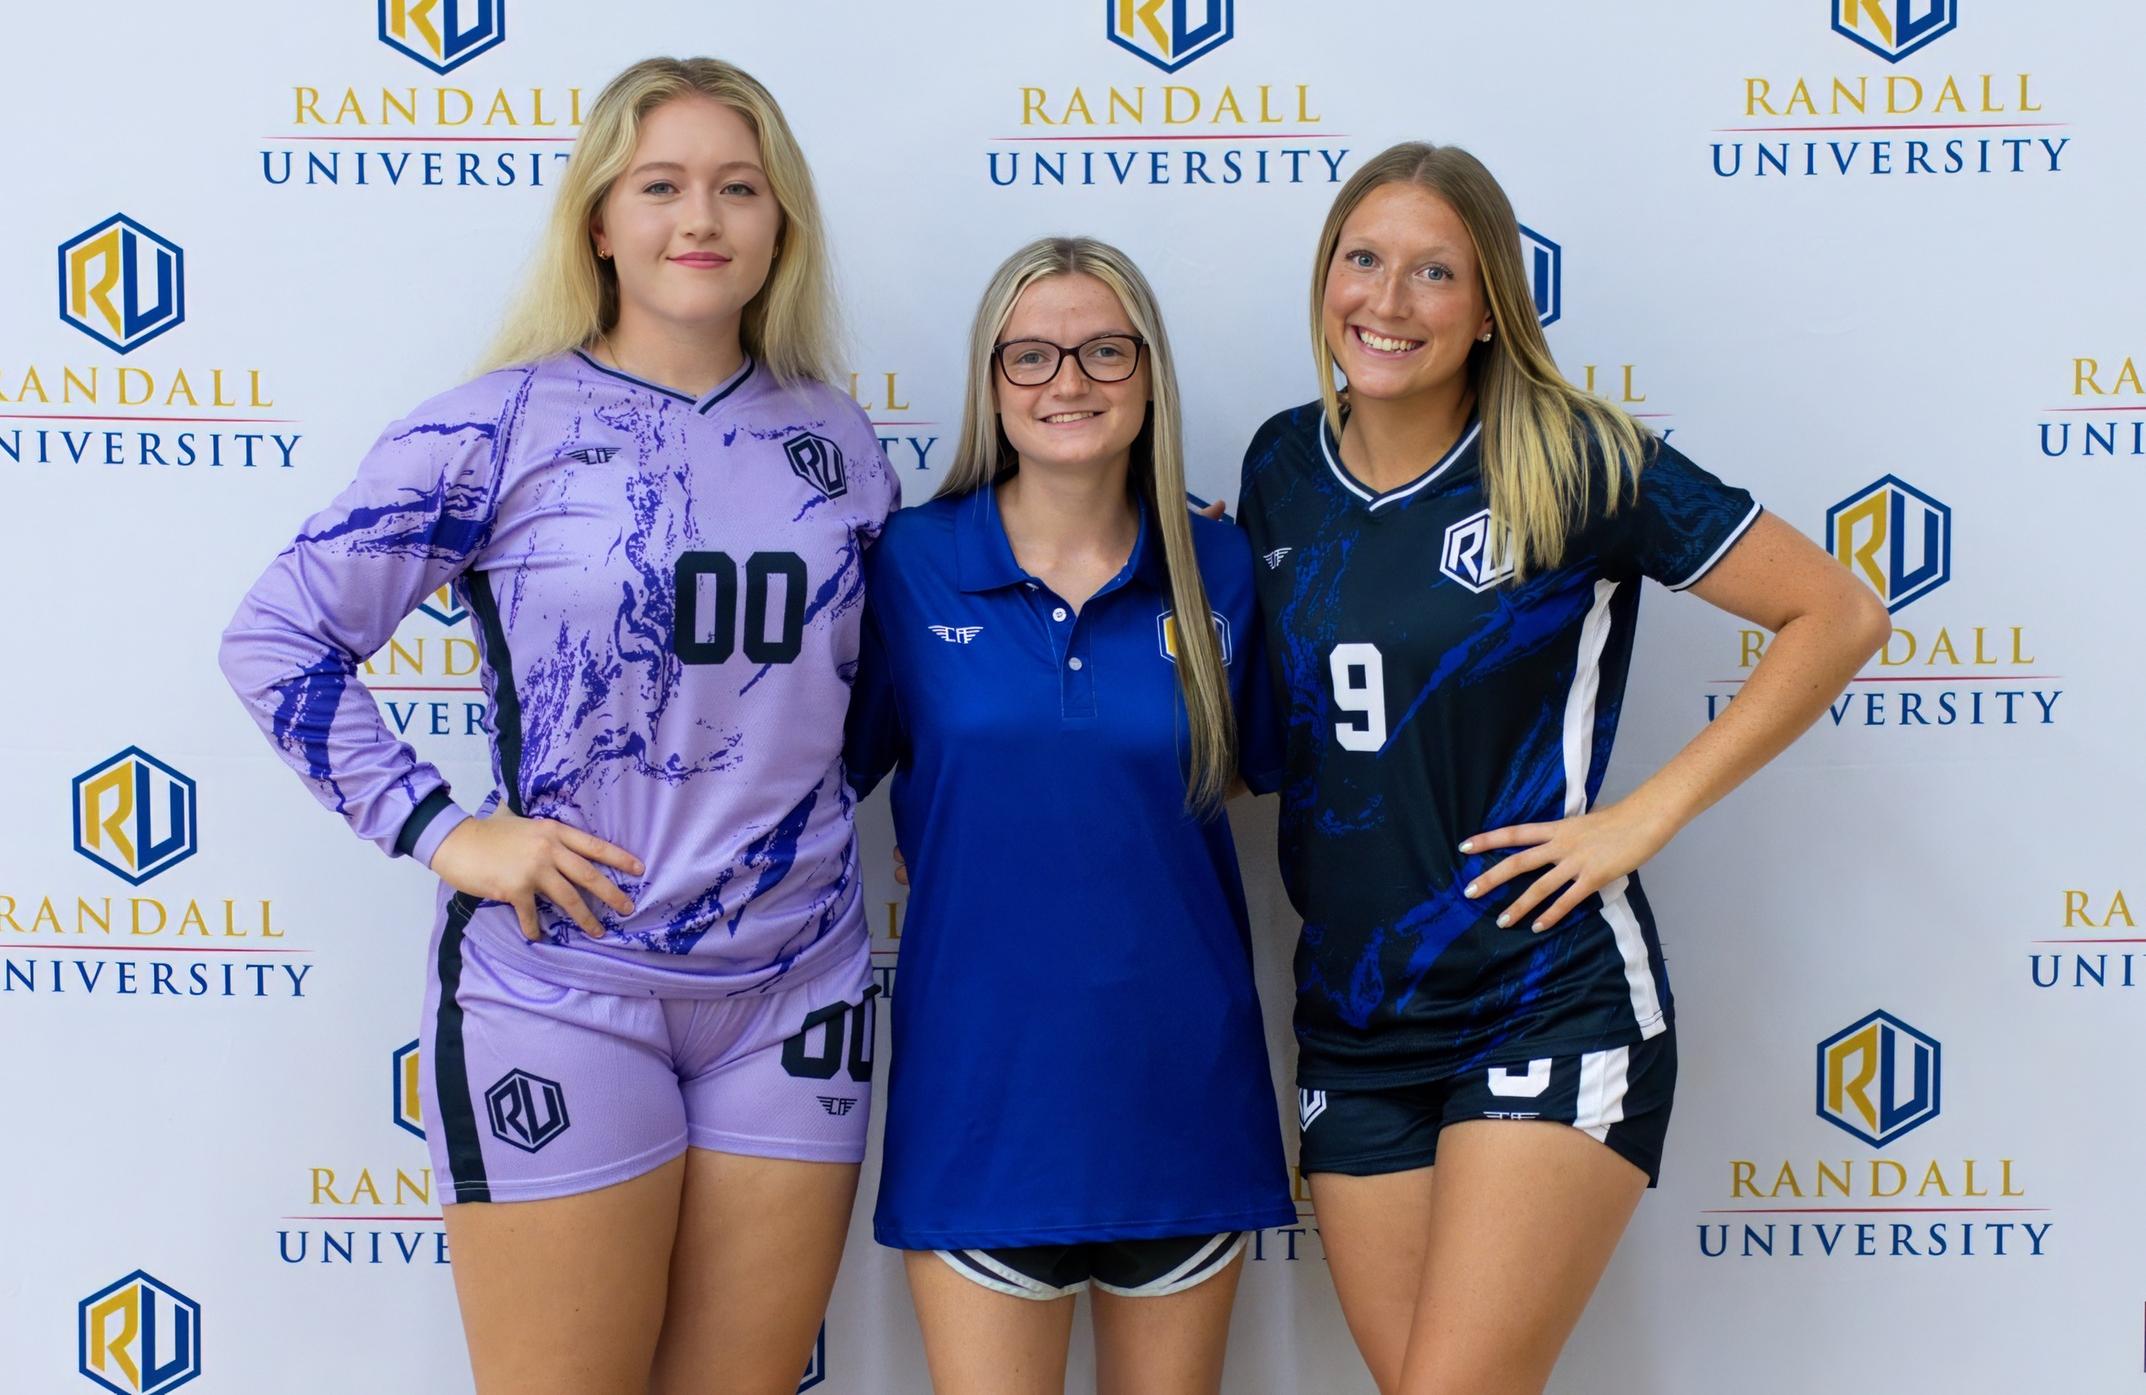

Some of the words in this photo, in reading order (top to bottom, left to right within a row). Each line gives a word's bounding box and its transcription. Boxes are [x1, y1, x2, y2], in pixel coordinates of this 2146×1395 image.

[1021, 84, 1322, 126] RANDALL
[1744, 73, 2043, 118] RANDALL
[987, 148, 1350, 186] UNIVERSITY
[1709, 137, 2071, 178] UNIVERSITY
[71, 227, 172, 340] RU
[0, 365, 275, 409] ANDALL
[789, 438, 844, 493] RU
[1838, 488, 1939, 601] RU
[674, 551, 808, 665] 00
[1329, 643, 1387, 752] 9
[84, 759, 186, 872] RU
[1828, 1023, 1929, 1134] RU
[491, 1077, 562, 1145] RU
[1728, 1159, 2026, 1199] RANDALL
[1695, 1222, 2054, 1258] UNIVERSITY
[90, 1283, 190, 1394] RU
